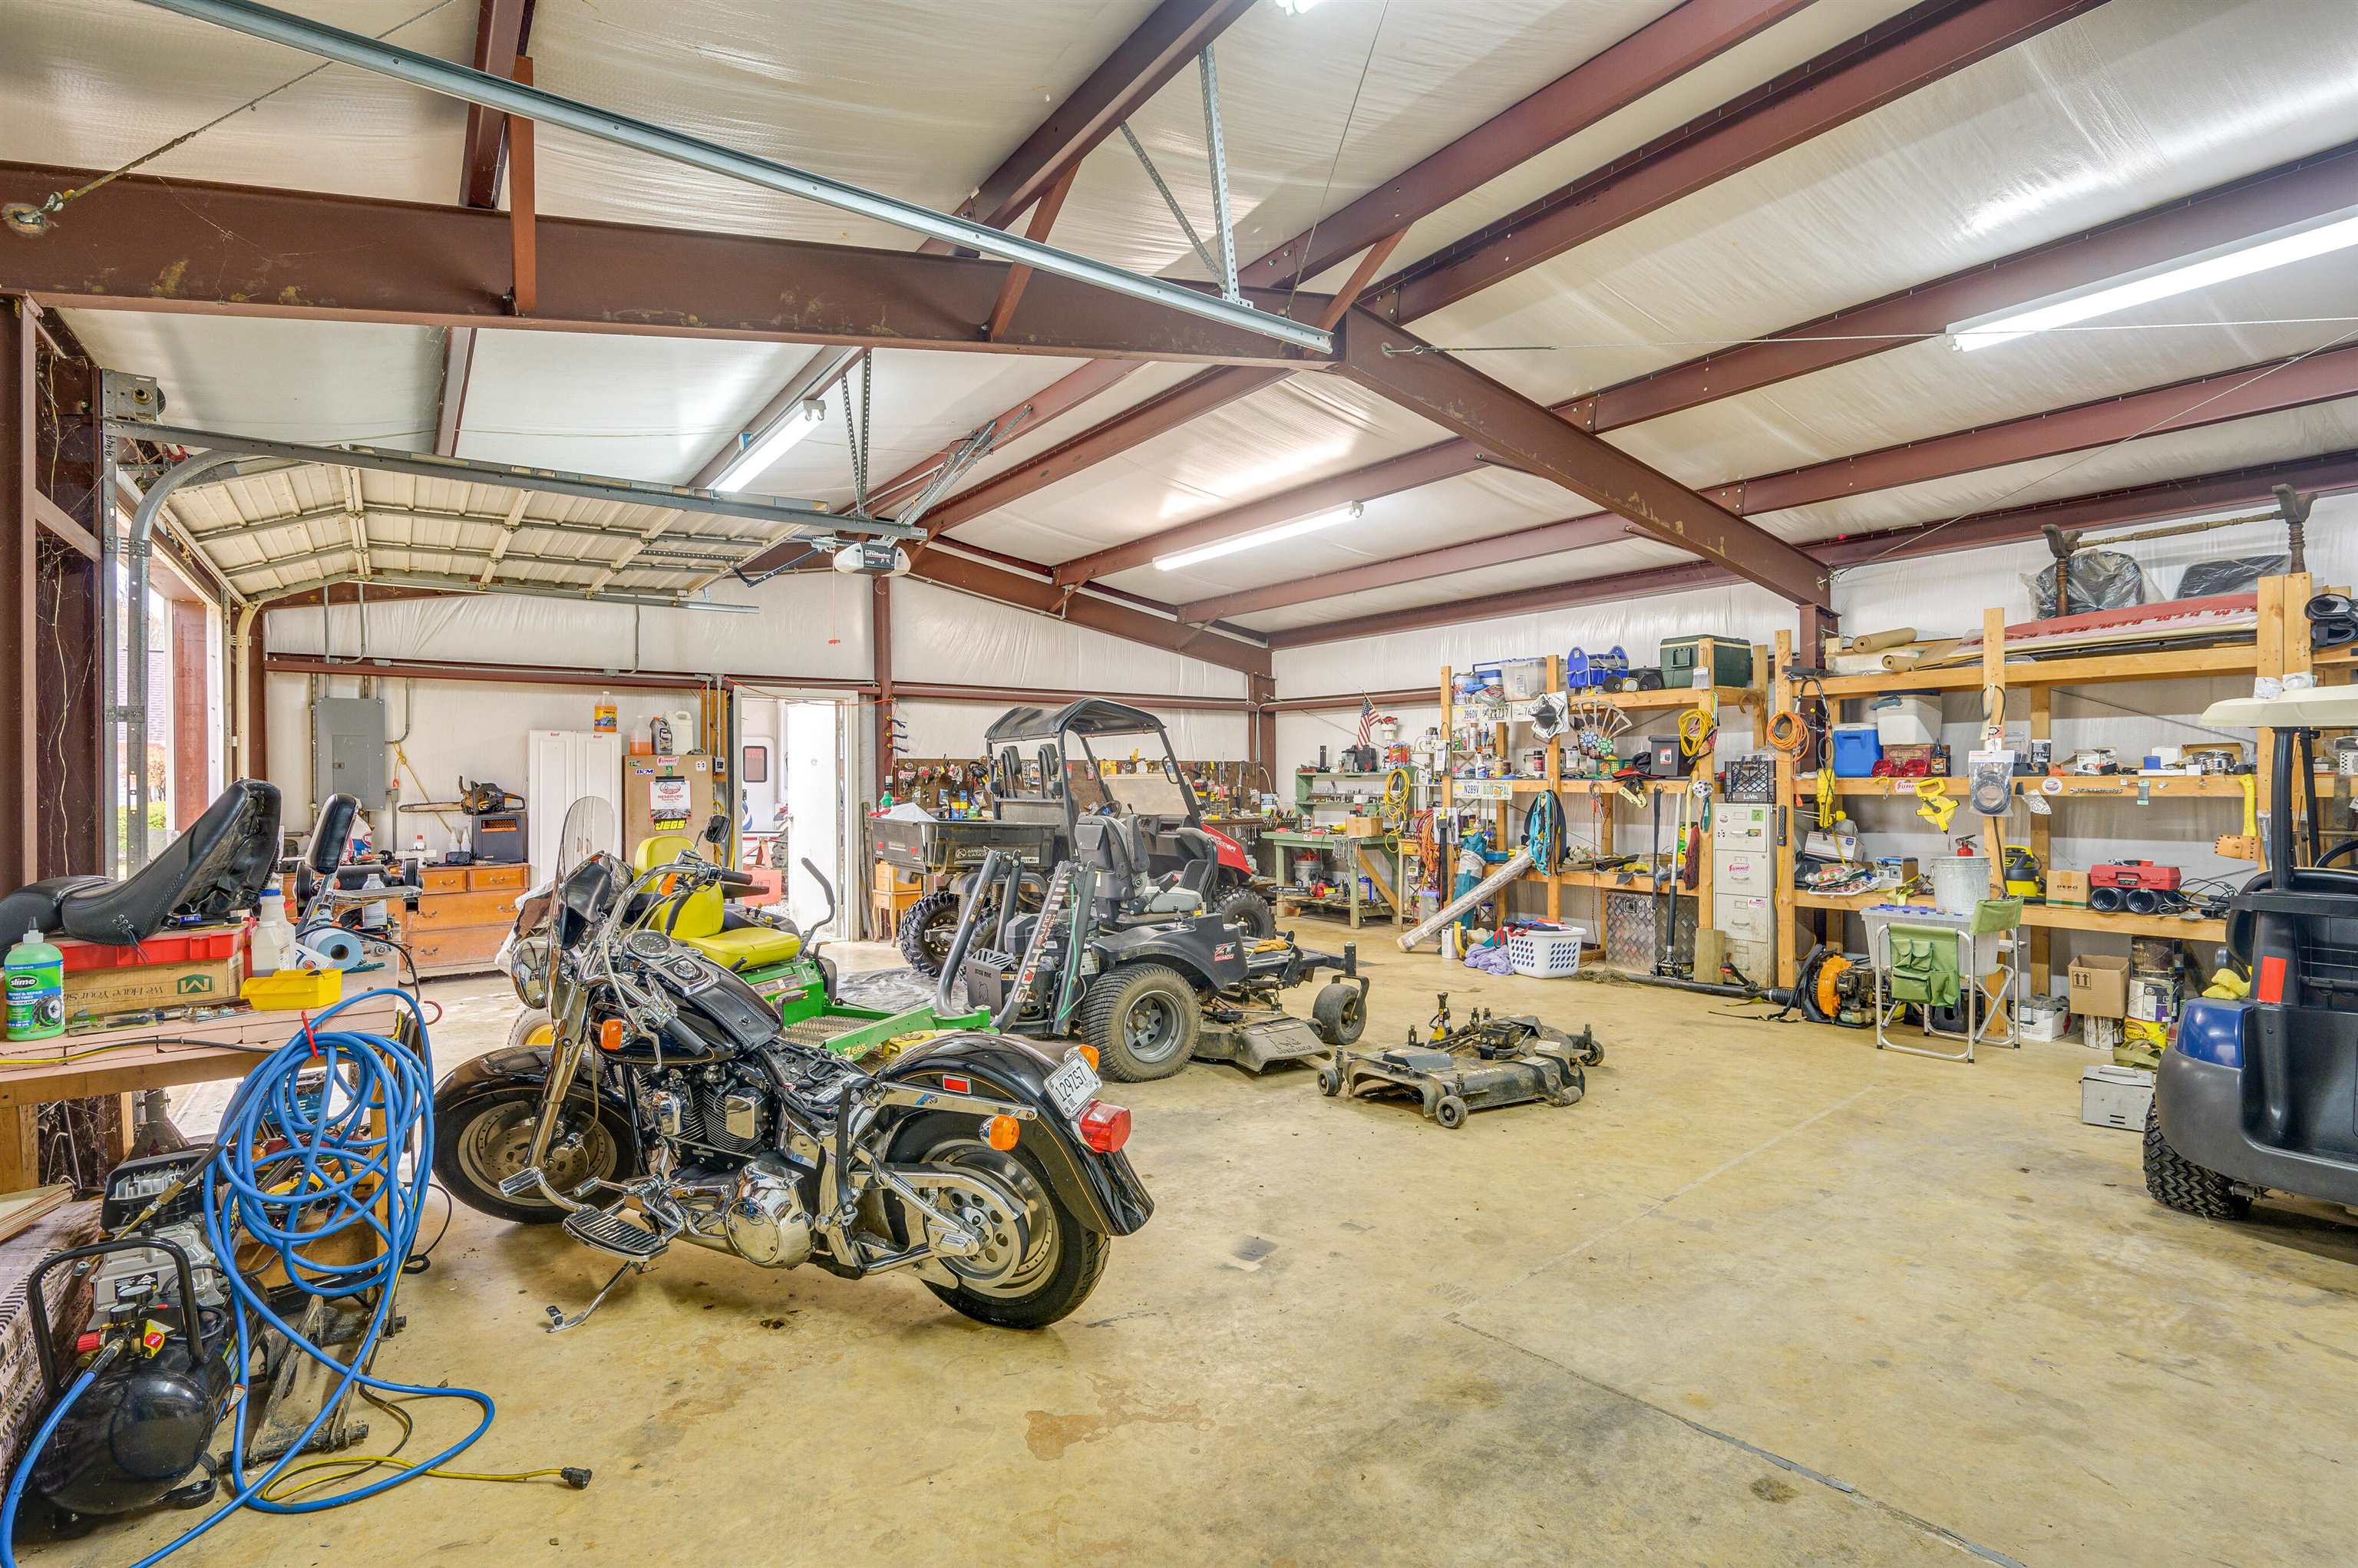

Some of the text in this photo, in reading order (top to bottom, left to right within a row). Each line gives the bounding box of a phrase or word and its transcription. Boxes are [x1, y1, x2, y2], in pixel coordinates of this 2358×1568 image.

[1038, 913, 1052, 940] DUTY
[112, 988, 144, 997] Have
[146, 985, 164, 994] We
[81, 990, 109, 999] Your
[843, 1043, 867, 1058] Z665
